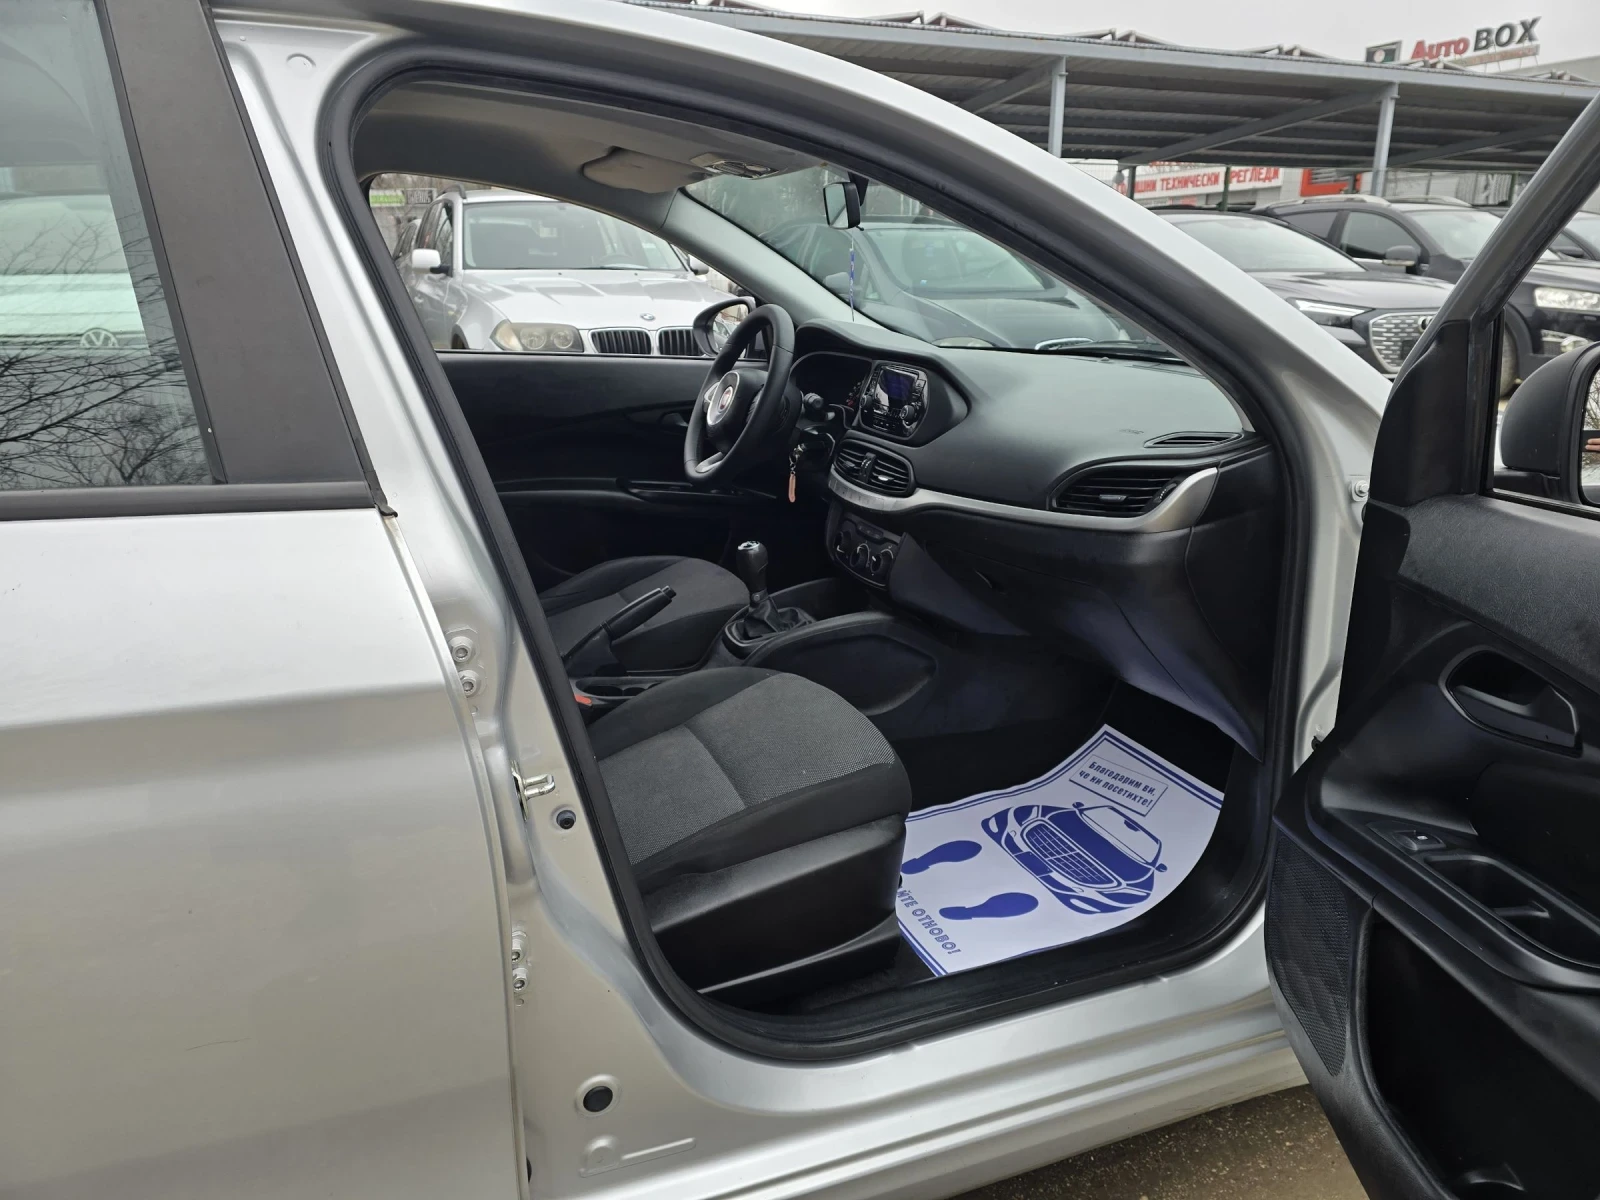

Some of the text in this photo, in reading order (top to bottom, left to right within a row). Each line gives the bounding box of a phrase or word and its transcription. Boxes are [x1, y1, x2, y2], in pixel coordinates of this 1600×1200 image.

[1473, 16, 1542, 52] BOX
[1160, 172, 1220, 191] ТЕХНИЧЕСКИ
[1228, 167, 1280, 184] РЕГЛЕДИ
[1079, 770, 1153, 807] че ни посетихте!
[1088, 761, 1143, 789] Благодарим
[897, 889, 961, 954] ЙТЕ ОТНОВО!
